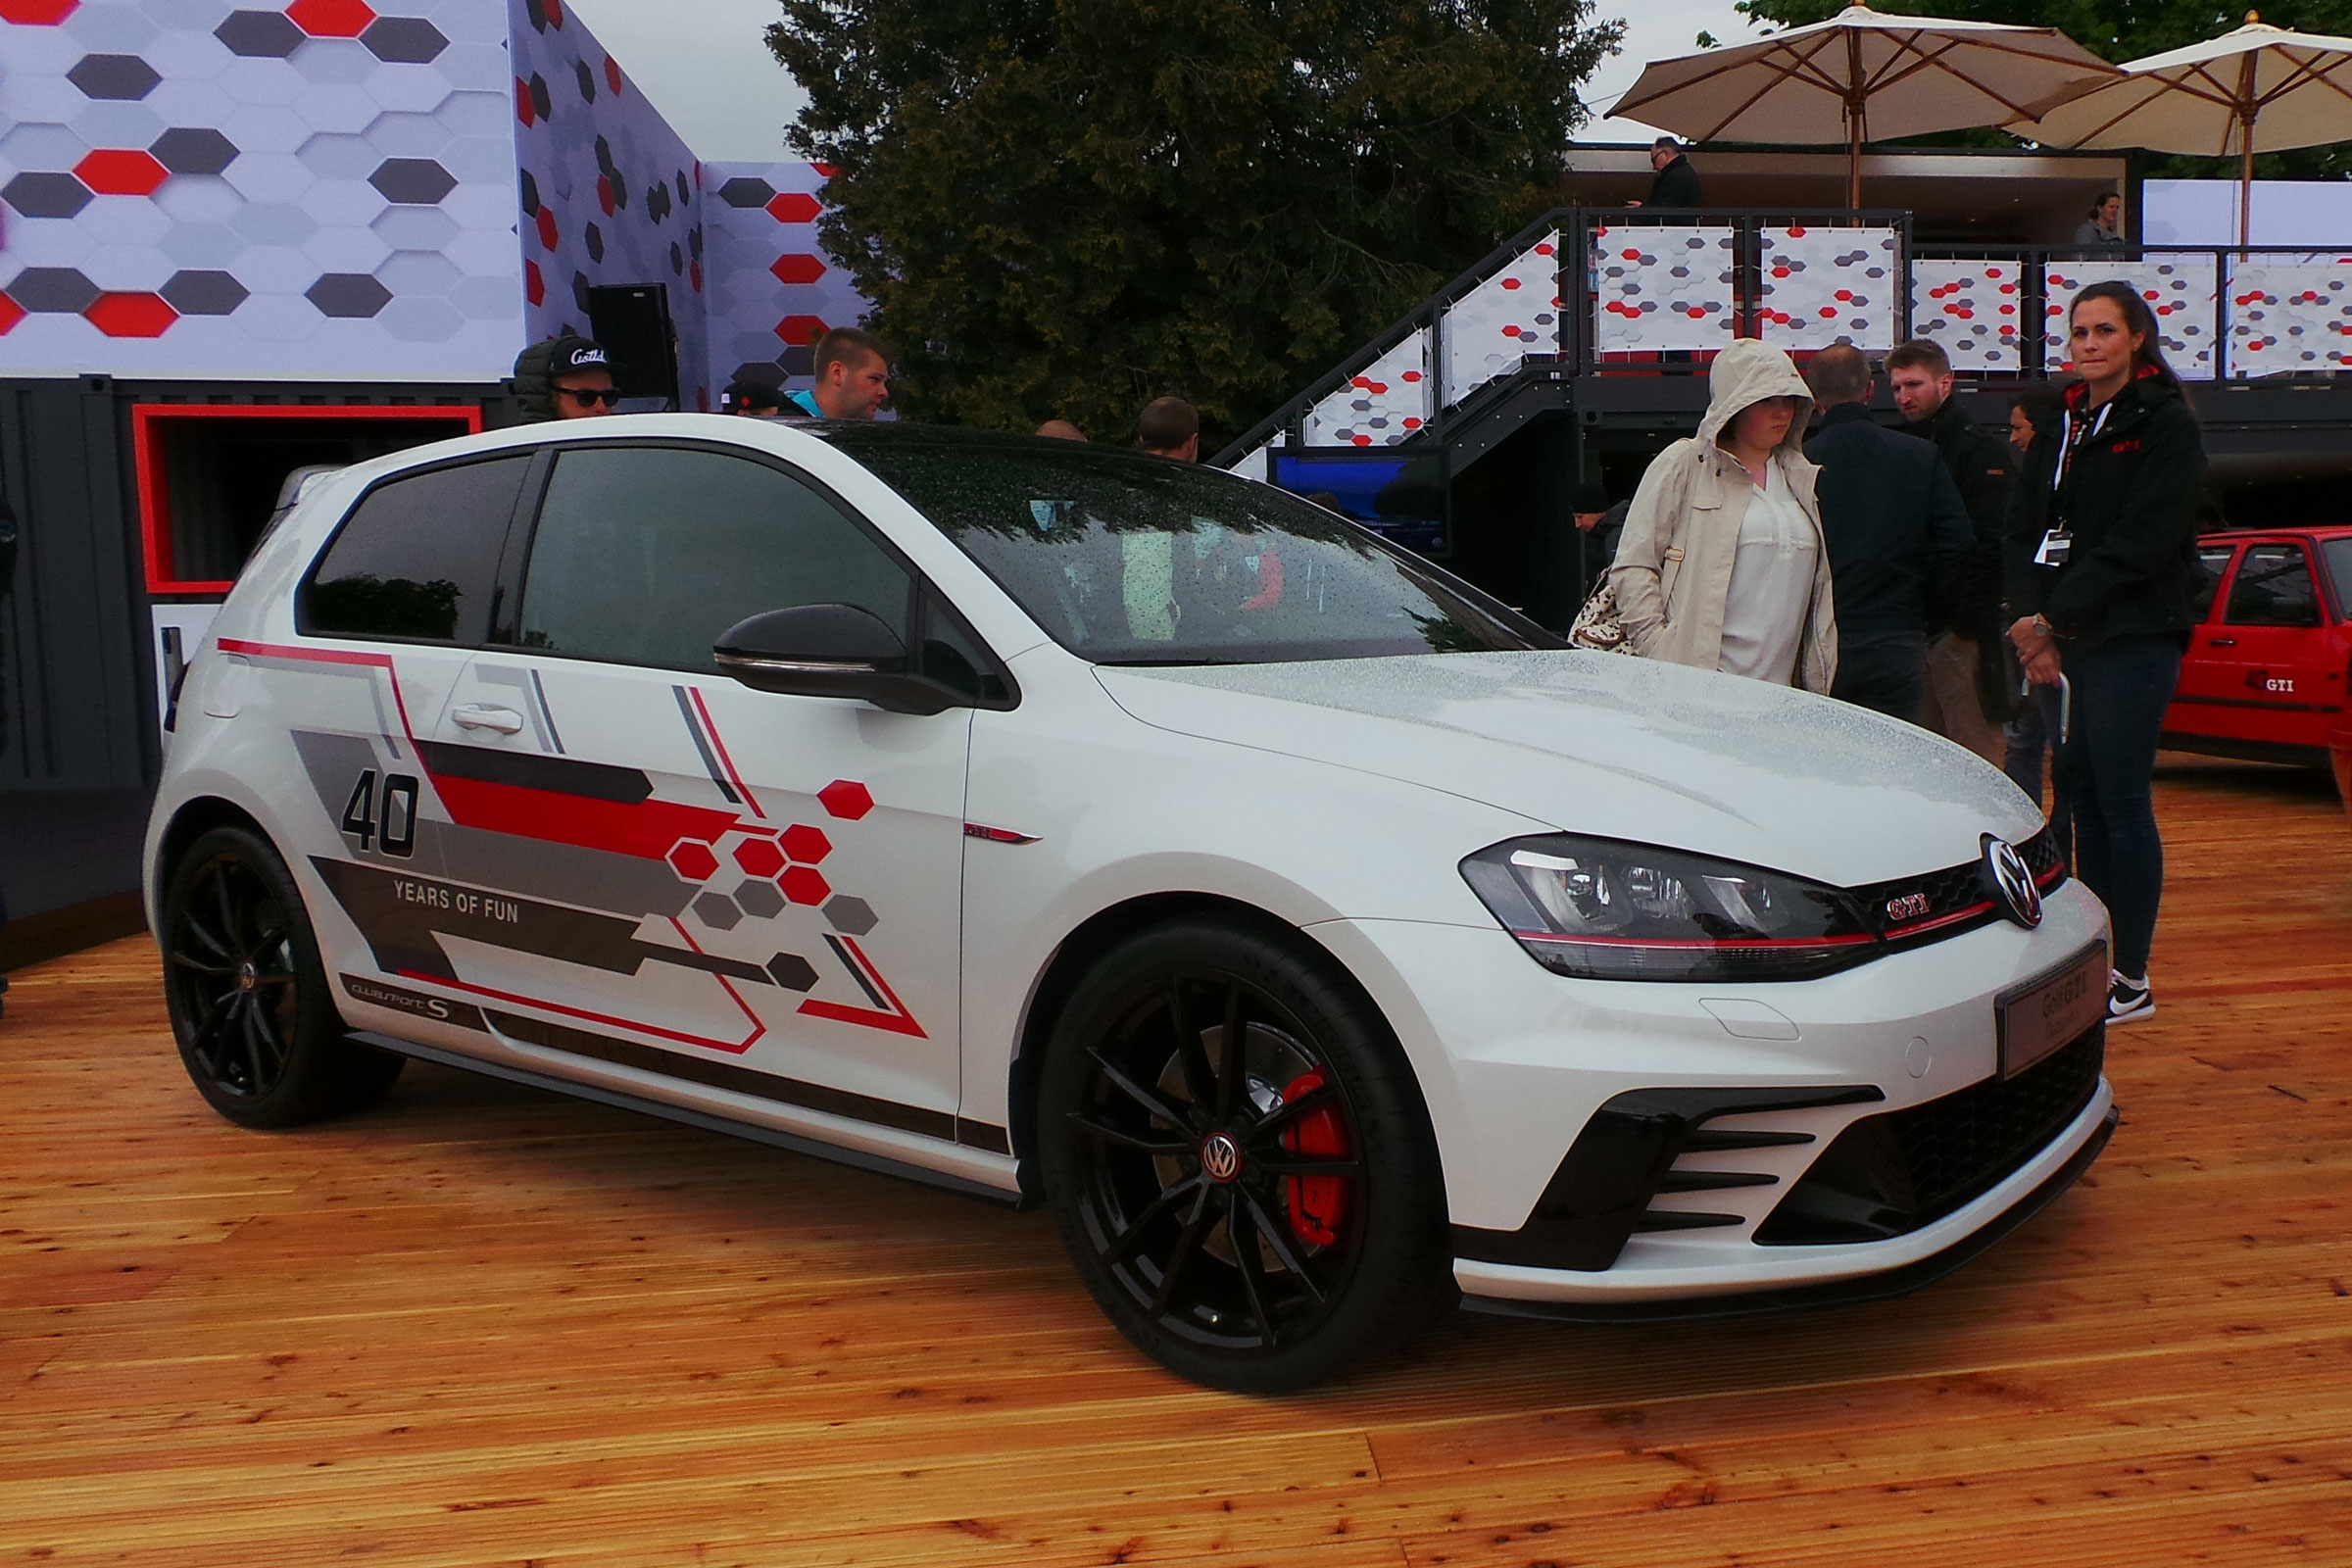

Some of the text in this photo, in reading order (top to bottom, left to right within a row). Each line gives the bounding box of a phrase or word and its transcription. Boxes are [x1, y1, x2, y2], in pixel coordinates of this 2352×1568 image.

[2266, 678, 2294, 692] GTI
[341, 767, 419, 860] 40
[394, 880, 518, 924] YEARS OF FUN
[1886, 892, 1931, 921] GTI
[426, 999, 449, 1018] S
